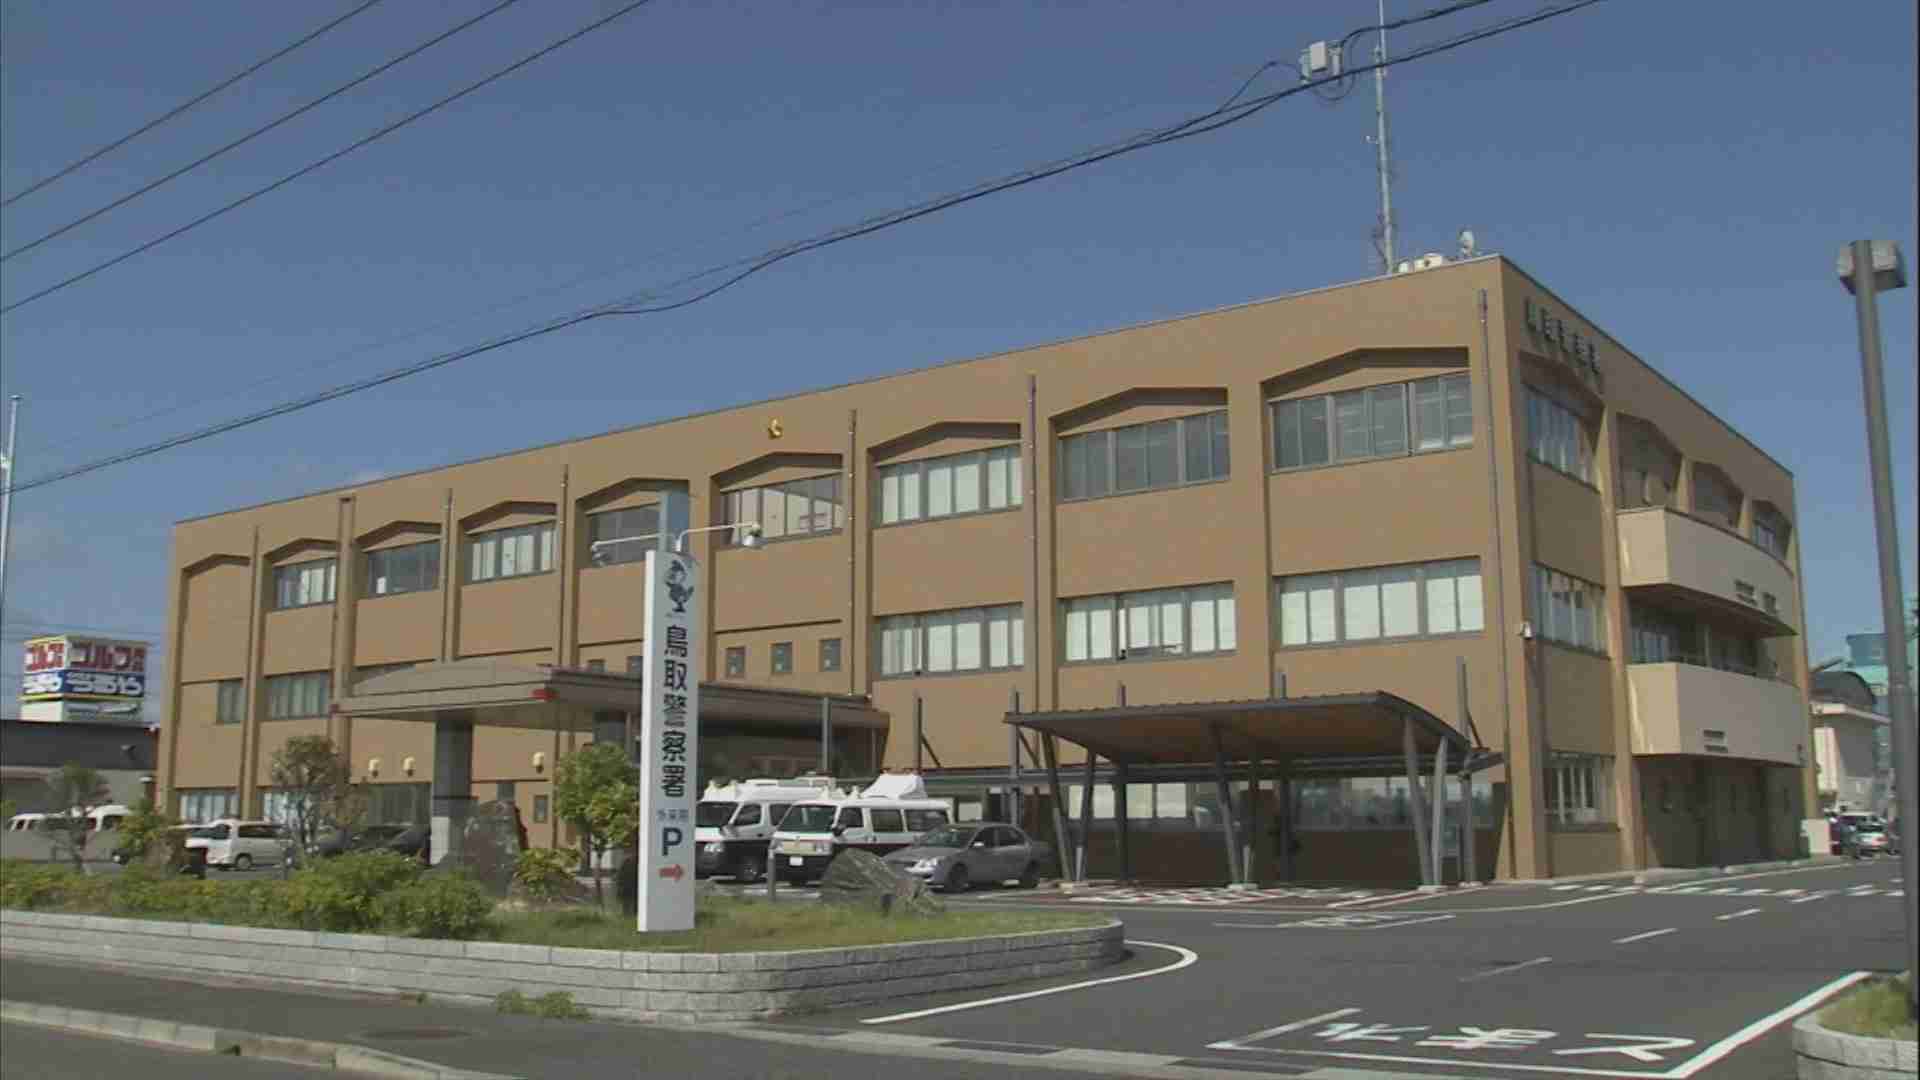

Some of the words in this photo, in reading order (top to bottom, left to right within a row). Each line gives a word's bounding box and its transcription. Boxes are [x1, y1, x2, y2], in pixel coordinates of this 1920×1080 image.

[662, 625, 688, 798] 鳥取警察署
[662, 827, 682, 856] P
